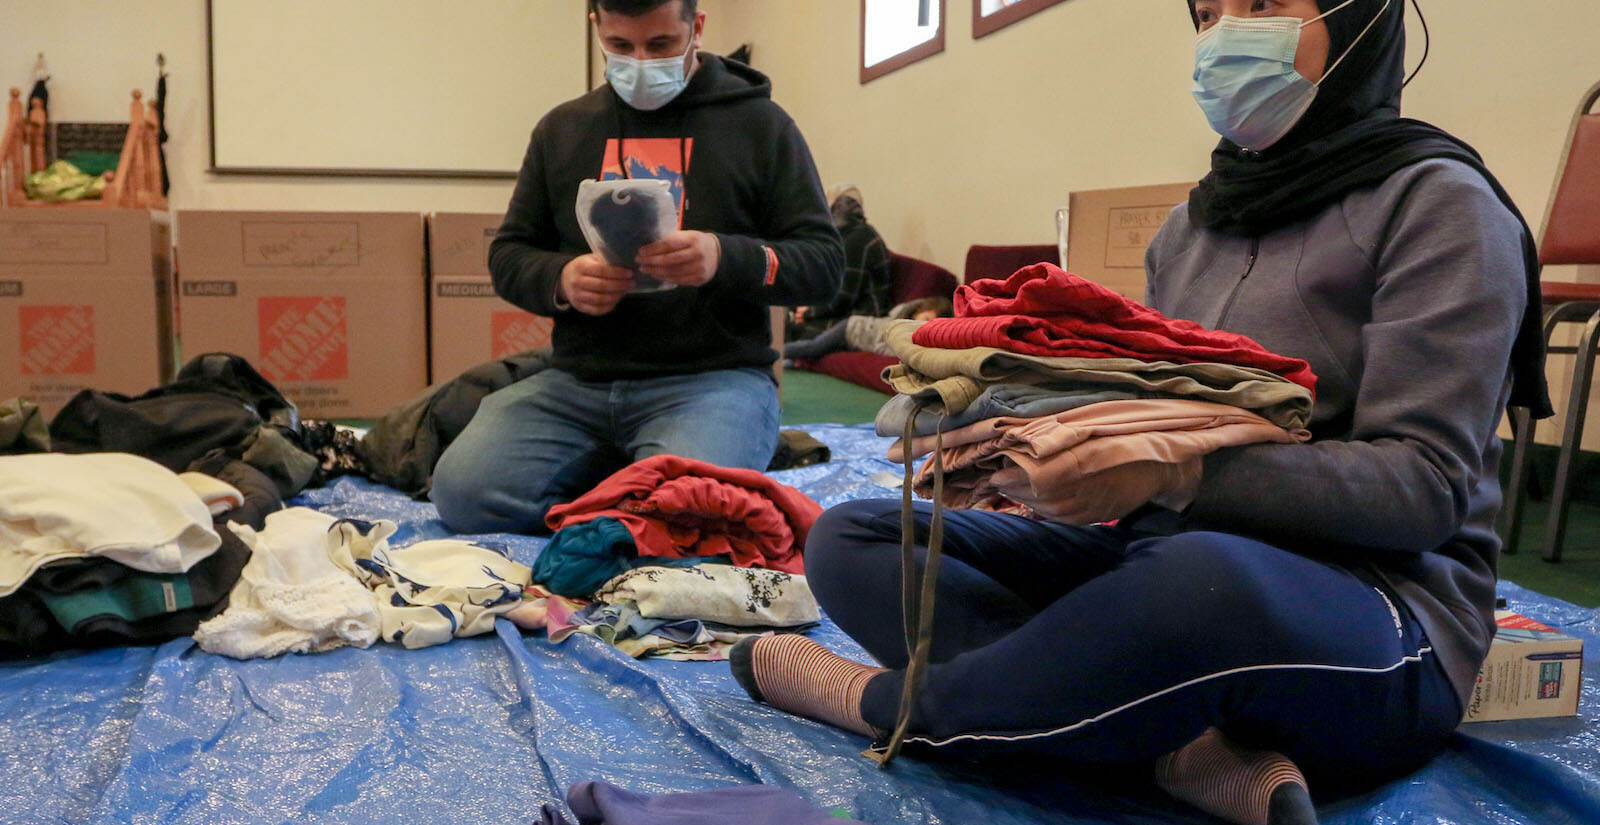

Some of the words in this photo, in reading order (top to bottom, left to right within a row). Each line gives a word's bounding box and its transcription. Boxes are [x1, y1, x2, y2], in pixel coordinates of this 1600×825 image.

[186, 283, 231, 295] LARGE
[265, 308, 300, 338] THE
[261, 296, 345, 381] HOME
